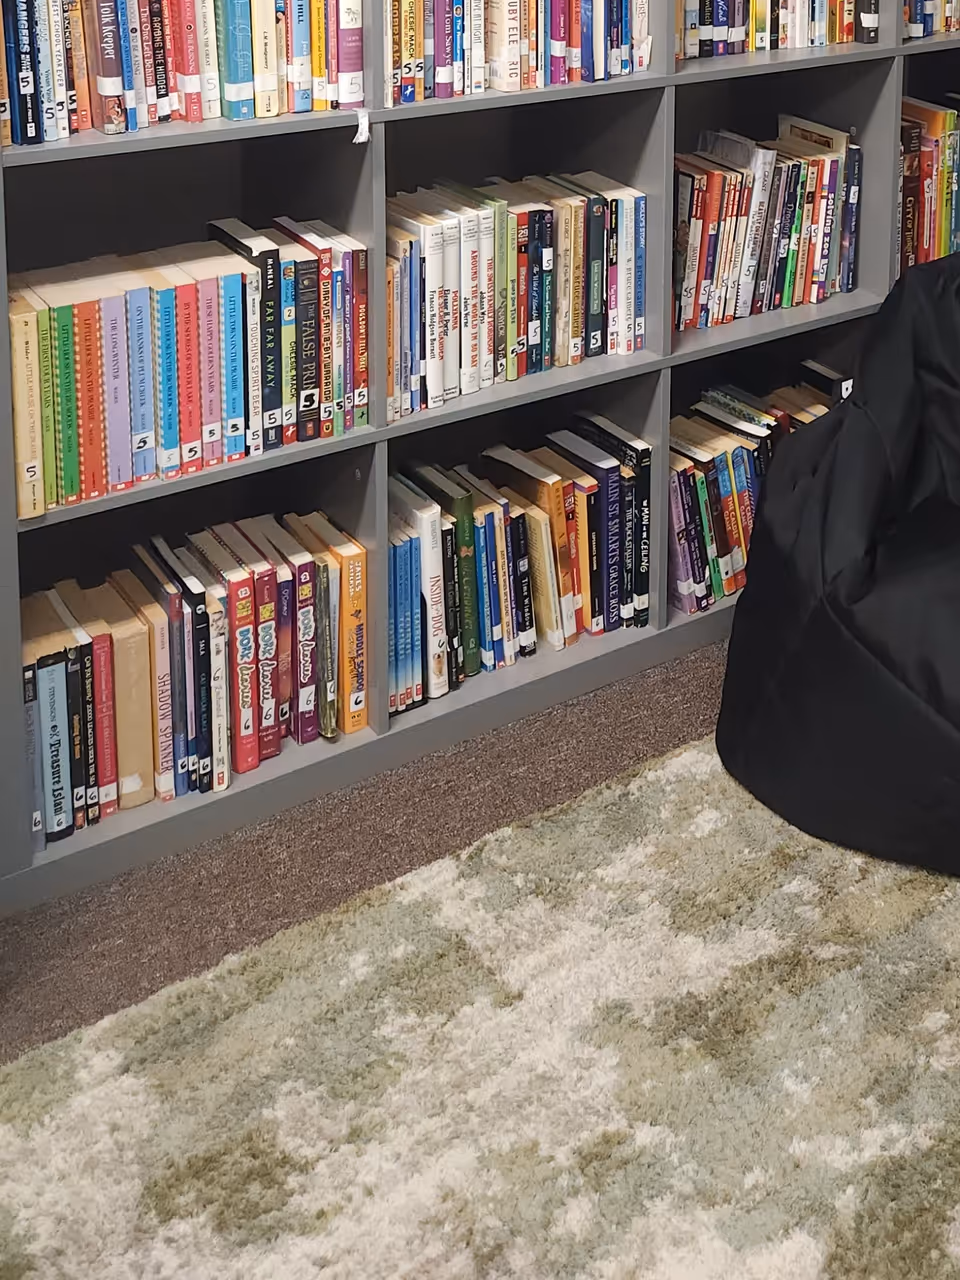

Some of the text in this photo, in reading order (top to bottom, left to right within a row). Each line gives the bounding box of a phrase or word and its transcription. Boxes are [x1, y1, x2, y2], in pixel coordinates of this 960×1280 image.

[100, 2, 114, 24] Folk
[445, 13, 453, 33] Tom
[102, 26, 116, 60] Keeper
[140, 7, 155, 86] The One Left Behind
[508, 27, 518, 78] ELERIC
[21, 76, 31, 88] 5
[348, 77, 360, 94] 5
[822, 193, 835, 255] solving zoe
[470, 249, 478, 281] AROUND
[321, 281, 330, 307] DIARY
[322, 308, 330, 321] OF
[323, 322, 331, 334] AN
[265, 301, 276, 387] FAR FAR AWAY
[302, 304, 319, 391] THE FALSE PRIN
[470, 343, 478, 352] 80
[471, 332, 478, 341] IN
[592, 334, 600, 347] 5
[250, 321, 260, 417] TOUCHING SPIRIT BEAR
[323, 362, 331, 401] WARRIOR
[267, 414, 277, 425] 5
[188, 446, 198, 458] 5
[26, 466, 38, 478] 5
[608, 473, 619, 501] MAIN
[608, 503, 618, 517] ST.
[641, 507, 649, 524] MAN
[609, 565, 619, 597] GRACE
[430, 574, 444, 637] INSIDE DOG
[610, 598, 619, 623] ROSS
[301, 609, 314, 681] DORK diaries
[356, 623, 365, 658] MIDDLE
[240, 627, 253, 709] DORK diaries
[157, 673, 173, 774] SHADOW SPINNER
